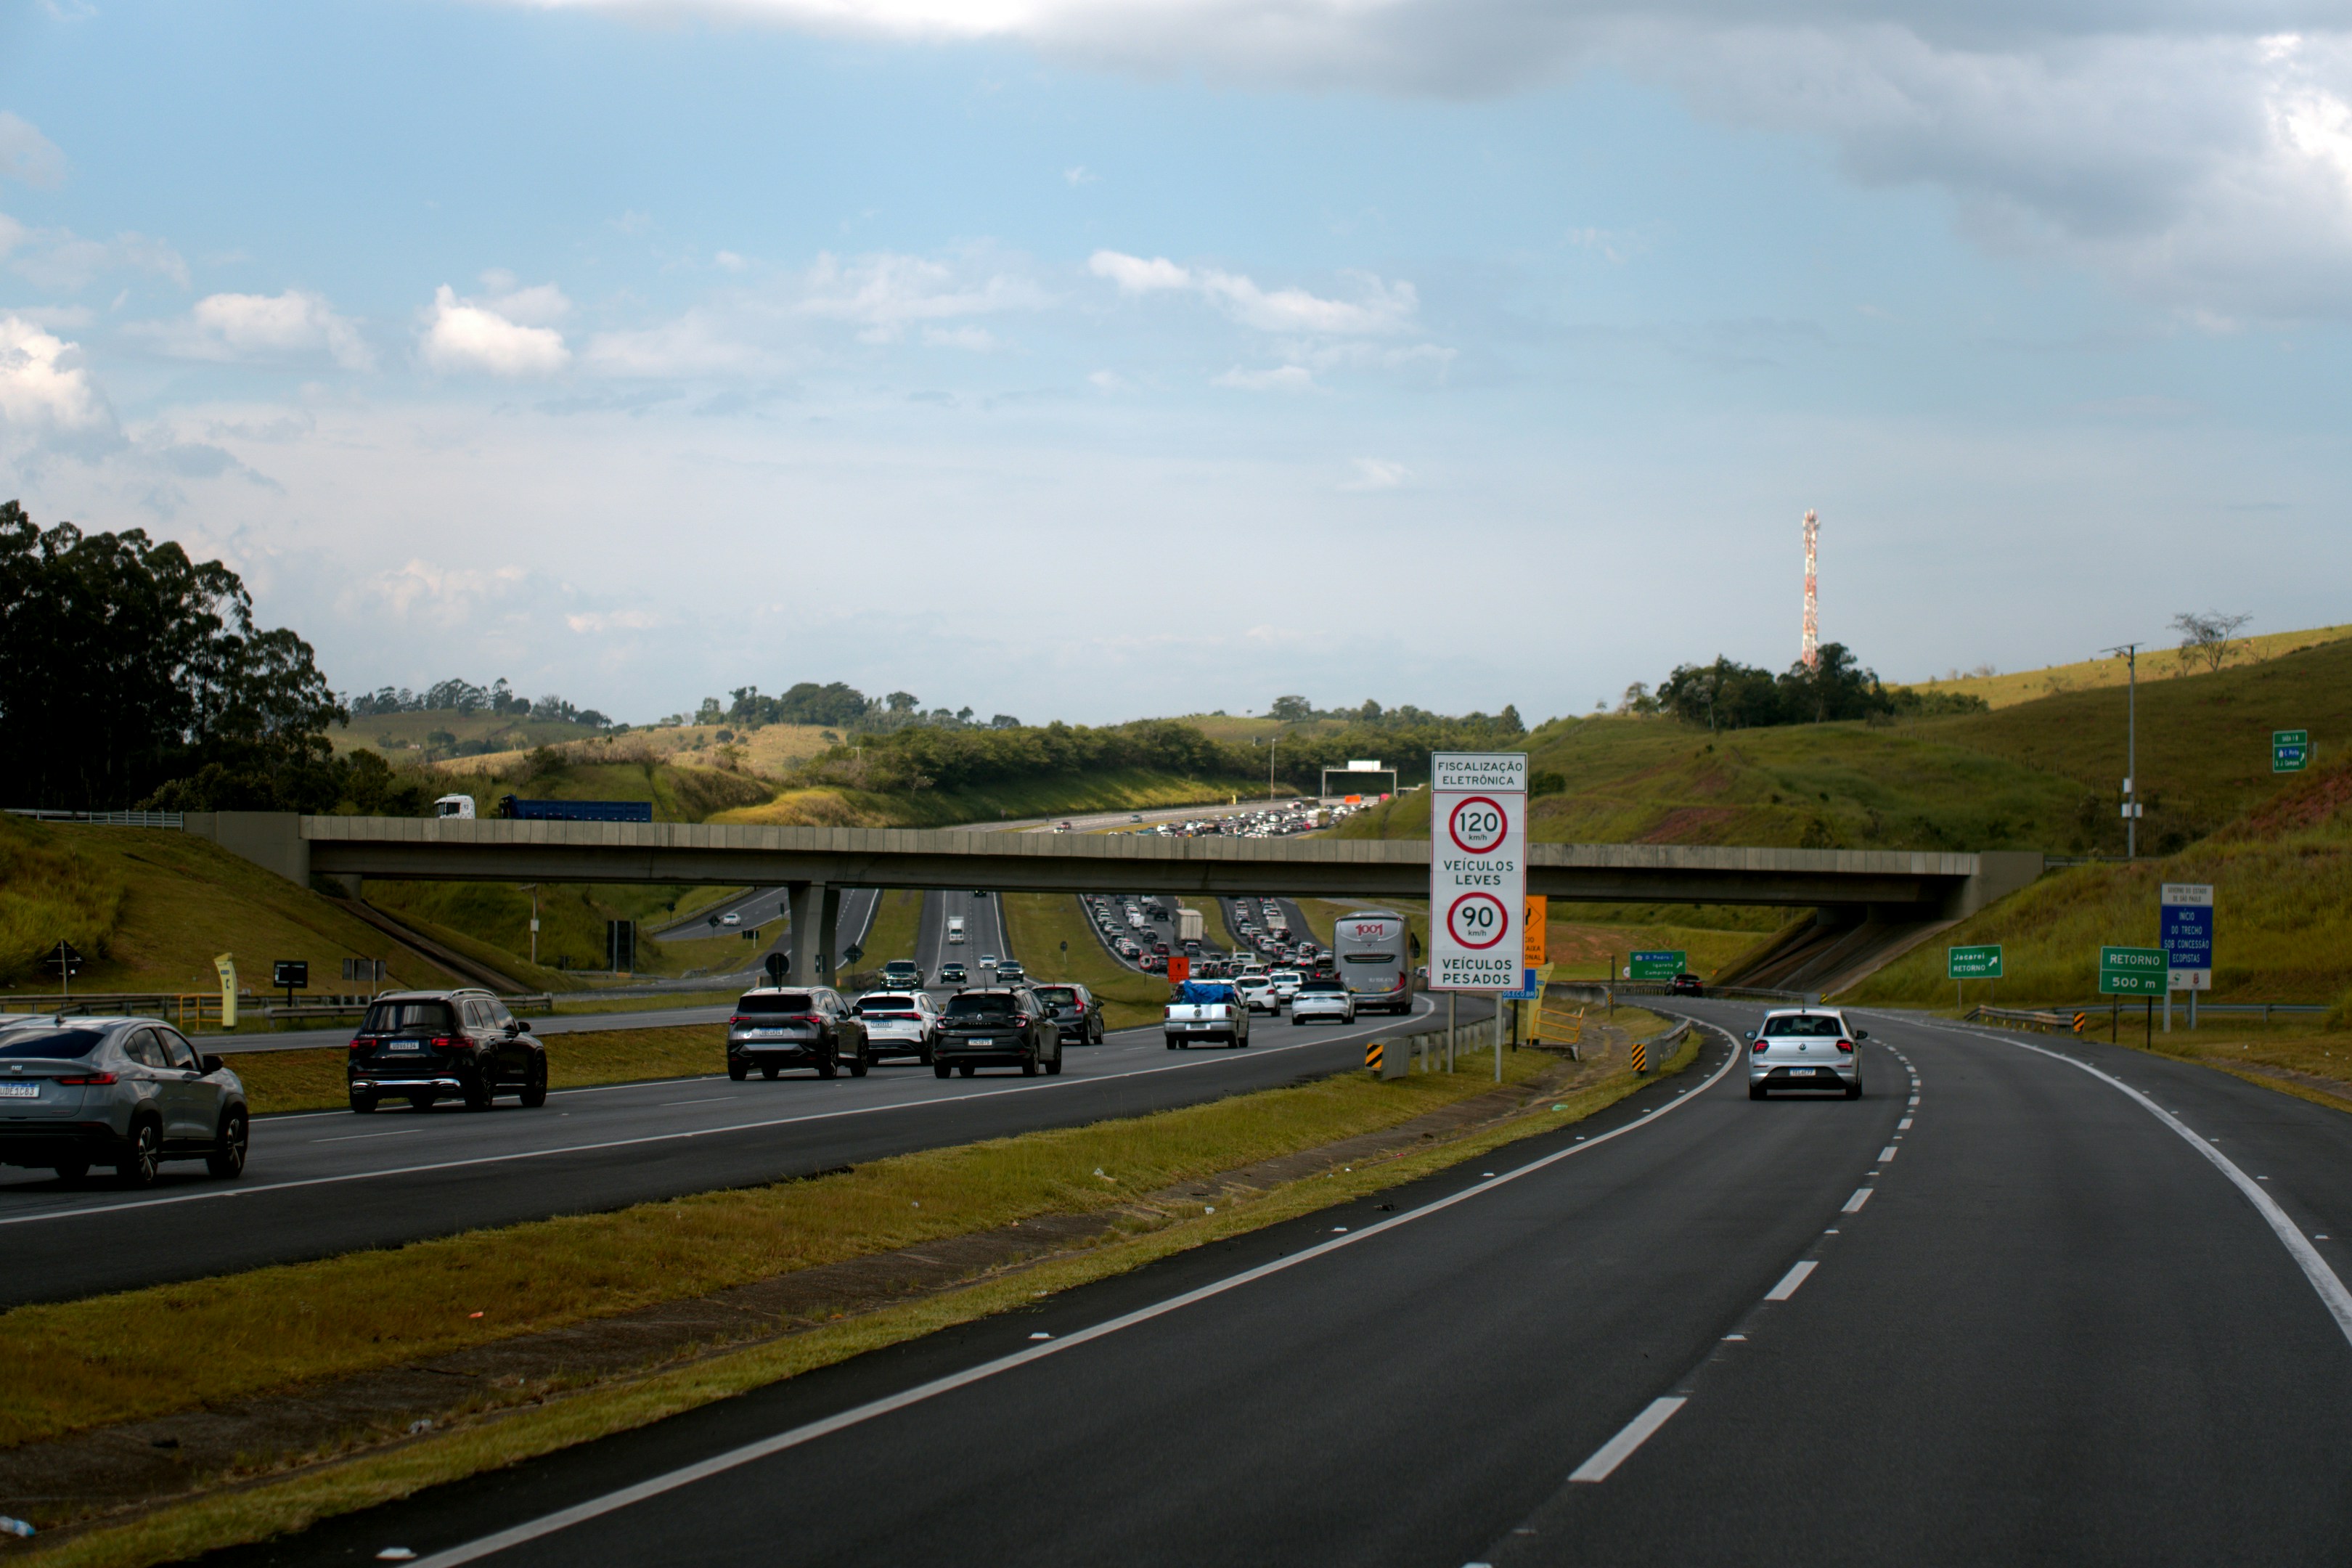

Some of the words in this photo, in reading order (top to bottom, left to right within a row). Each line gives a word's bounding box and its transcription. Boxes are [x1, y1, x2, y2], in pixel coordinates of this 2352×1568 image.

[1438, 761, 1523, 773] FISCALIZAÇÃO
[1442, 774, 1514, 785] ELETRÔNICA
[1460, 812, 1498, 832] 120
[1444, 857, 1514, 871] VEÍCULOS
[1455, 875, 1500, 885] LEVES
[1462, 907, 1493, 928] 90
[2179, 908, 2194, 920] INÍCIO
[1355, 923, 1383, 936] 1001
[2171, 926, 2179, 935] DO
[2181, 926, 2202, 935] TRECHO
[2164, 939, 2175, 949] SOB
[2178, 938, 2209, 949] CONCESSÃO
[1442, 956, 1512, 970] VEÍCULOS
[2110, 954, 2160, 966] RETORNO
[2172, 954, 2200, 963] ECOPISTAS
[1442, 973, 1511, 984] PESADOS
[2112, 976, 2138, 988] 500
[2145, 980, 2156, 989] m
